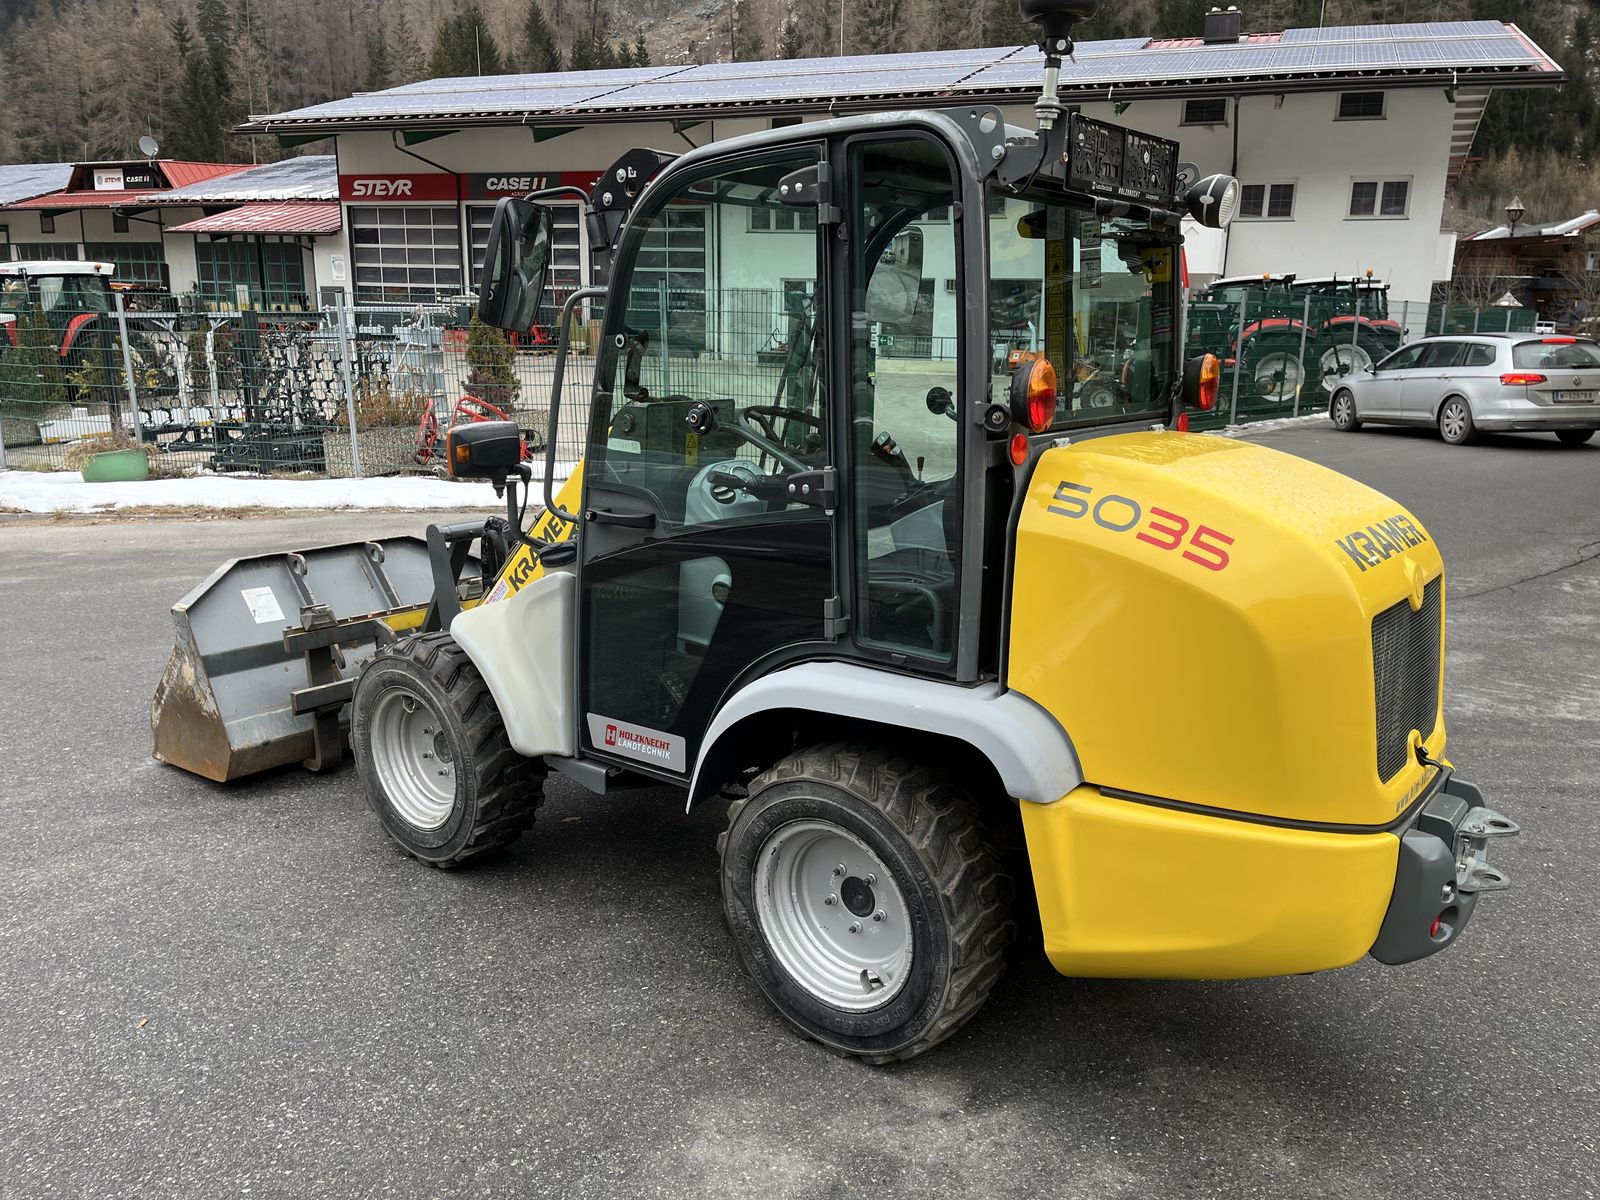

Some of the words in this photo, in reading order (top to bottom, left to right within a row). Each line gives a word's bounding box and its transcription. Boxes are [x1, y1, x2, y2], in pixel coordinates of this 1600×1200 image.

[126, 175, 143, 183] CASE
[351, 179, 413, 196] STEYR
[486, 177, 531, 190] CASE
[1046, 480, 1235, 572] 5035
[1334, 514, 1427, 573] KRAMER
[617, 739, 671, 760] LANDTECHNIK
[619, 729, 671, 751] HOLZKNECHT
